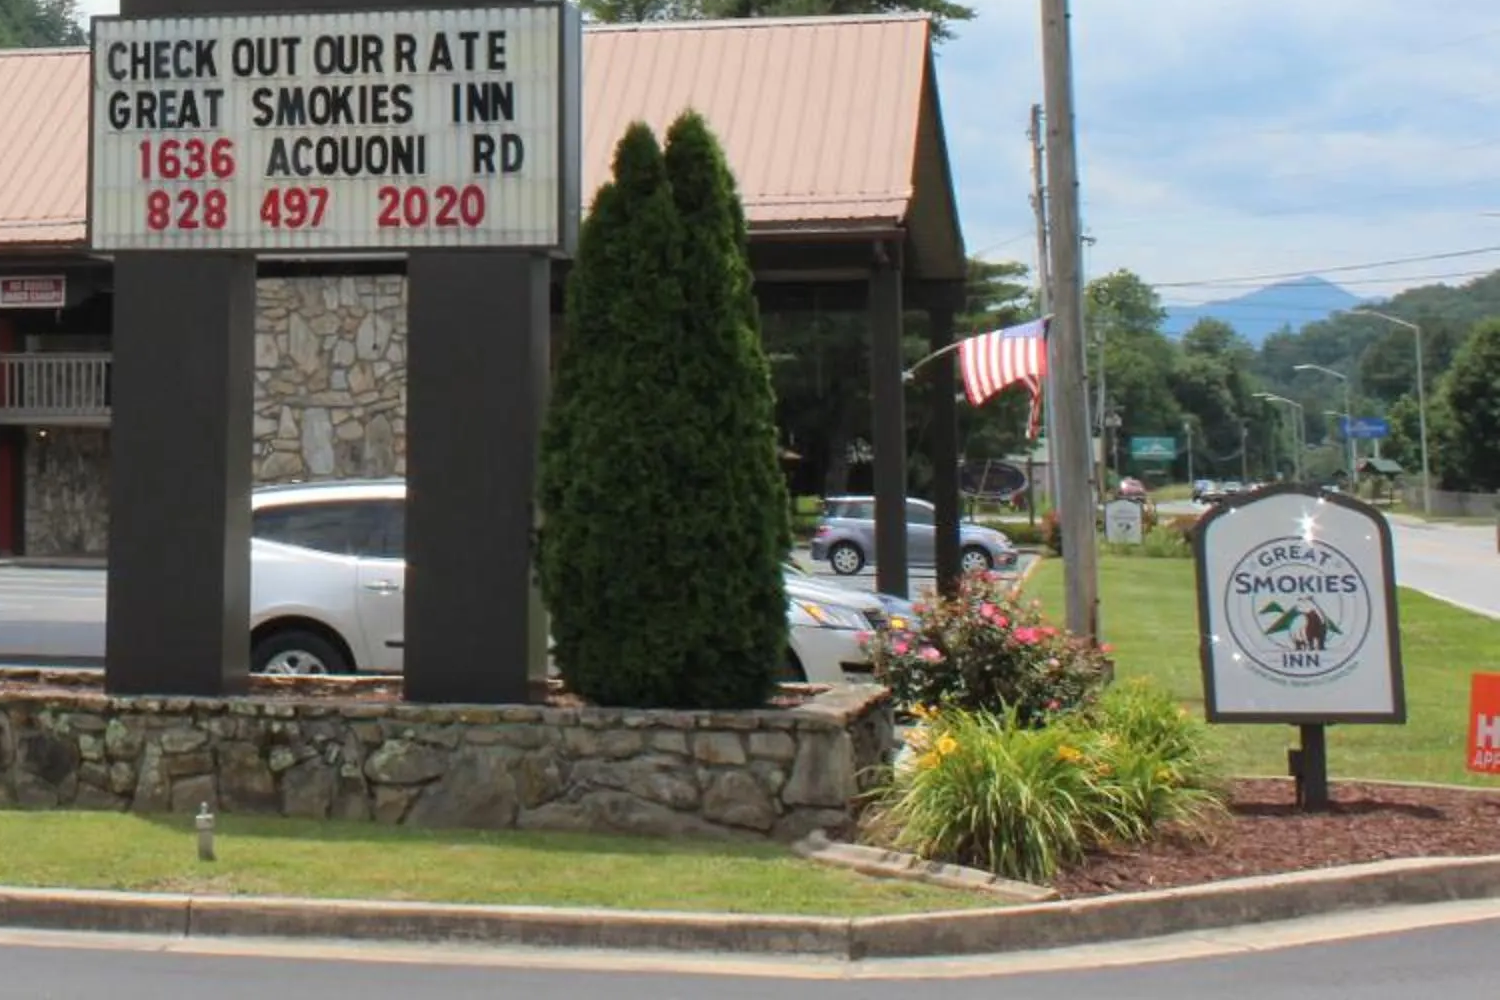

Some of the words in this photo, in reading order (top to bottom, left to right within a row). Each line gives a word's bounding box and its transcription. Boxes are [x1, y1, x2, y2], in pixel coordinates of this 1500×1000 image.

[106, 38, 218, 81] CHECK
[231, 36, 301, 77] OUT
[313, 33, 384, 75] OUR
[395, 30, 507, 73] RATE
[108, 87, 225, 130] GREAT
[252, 83, 414, 127] SMOKIES
[453, 81, 514, 122] INN
[139, 137, 236, 180] 1636
[265, 134, 426, 177] ACQUONI
[473, 133, 524, 174] RD
[146, 188, 227, 230] 828
[260, 186, 329, 229] 497
[377, 184, 486, 228] 2020
[1258, 545, 1331, 567] GREAT
[1235, 572, 1358, 594] SMOKIES
[1283, 653, 1320, 668] INN
